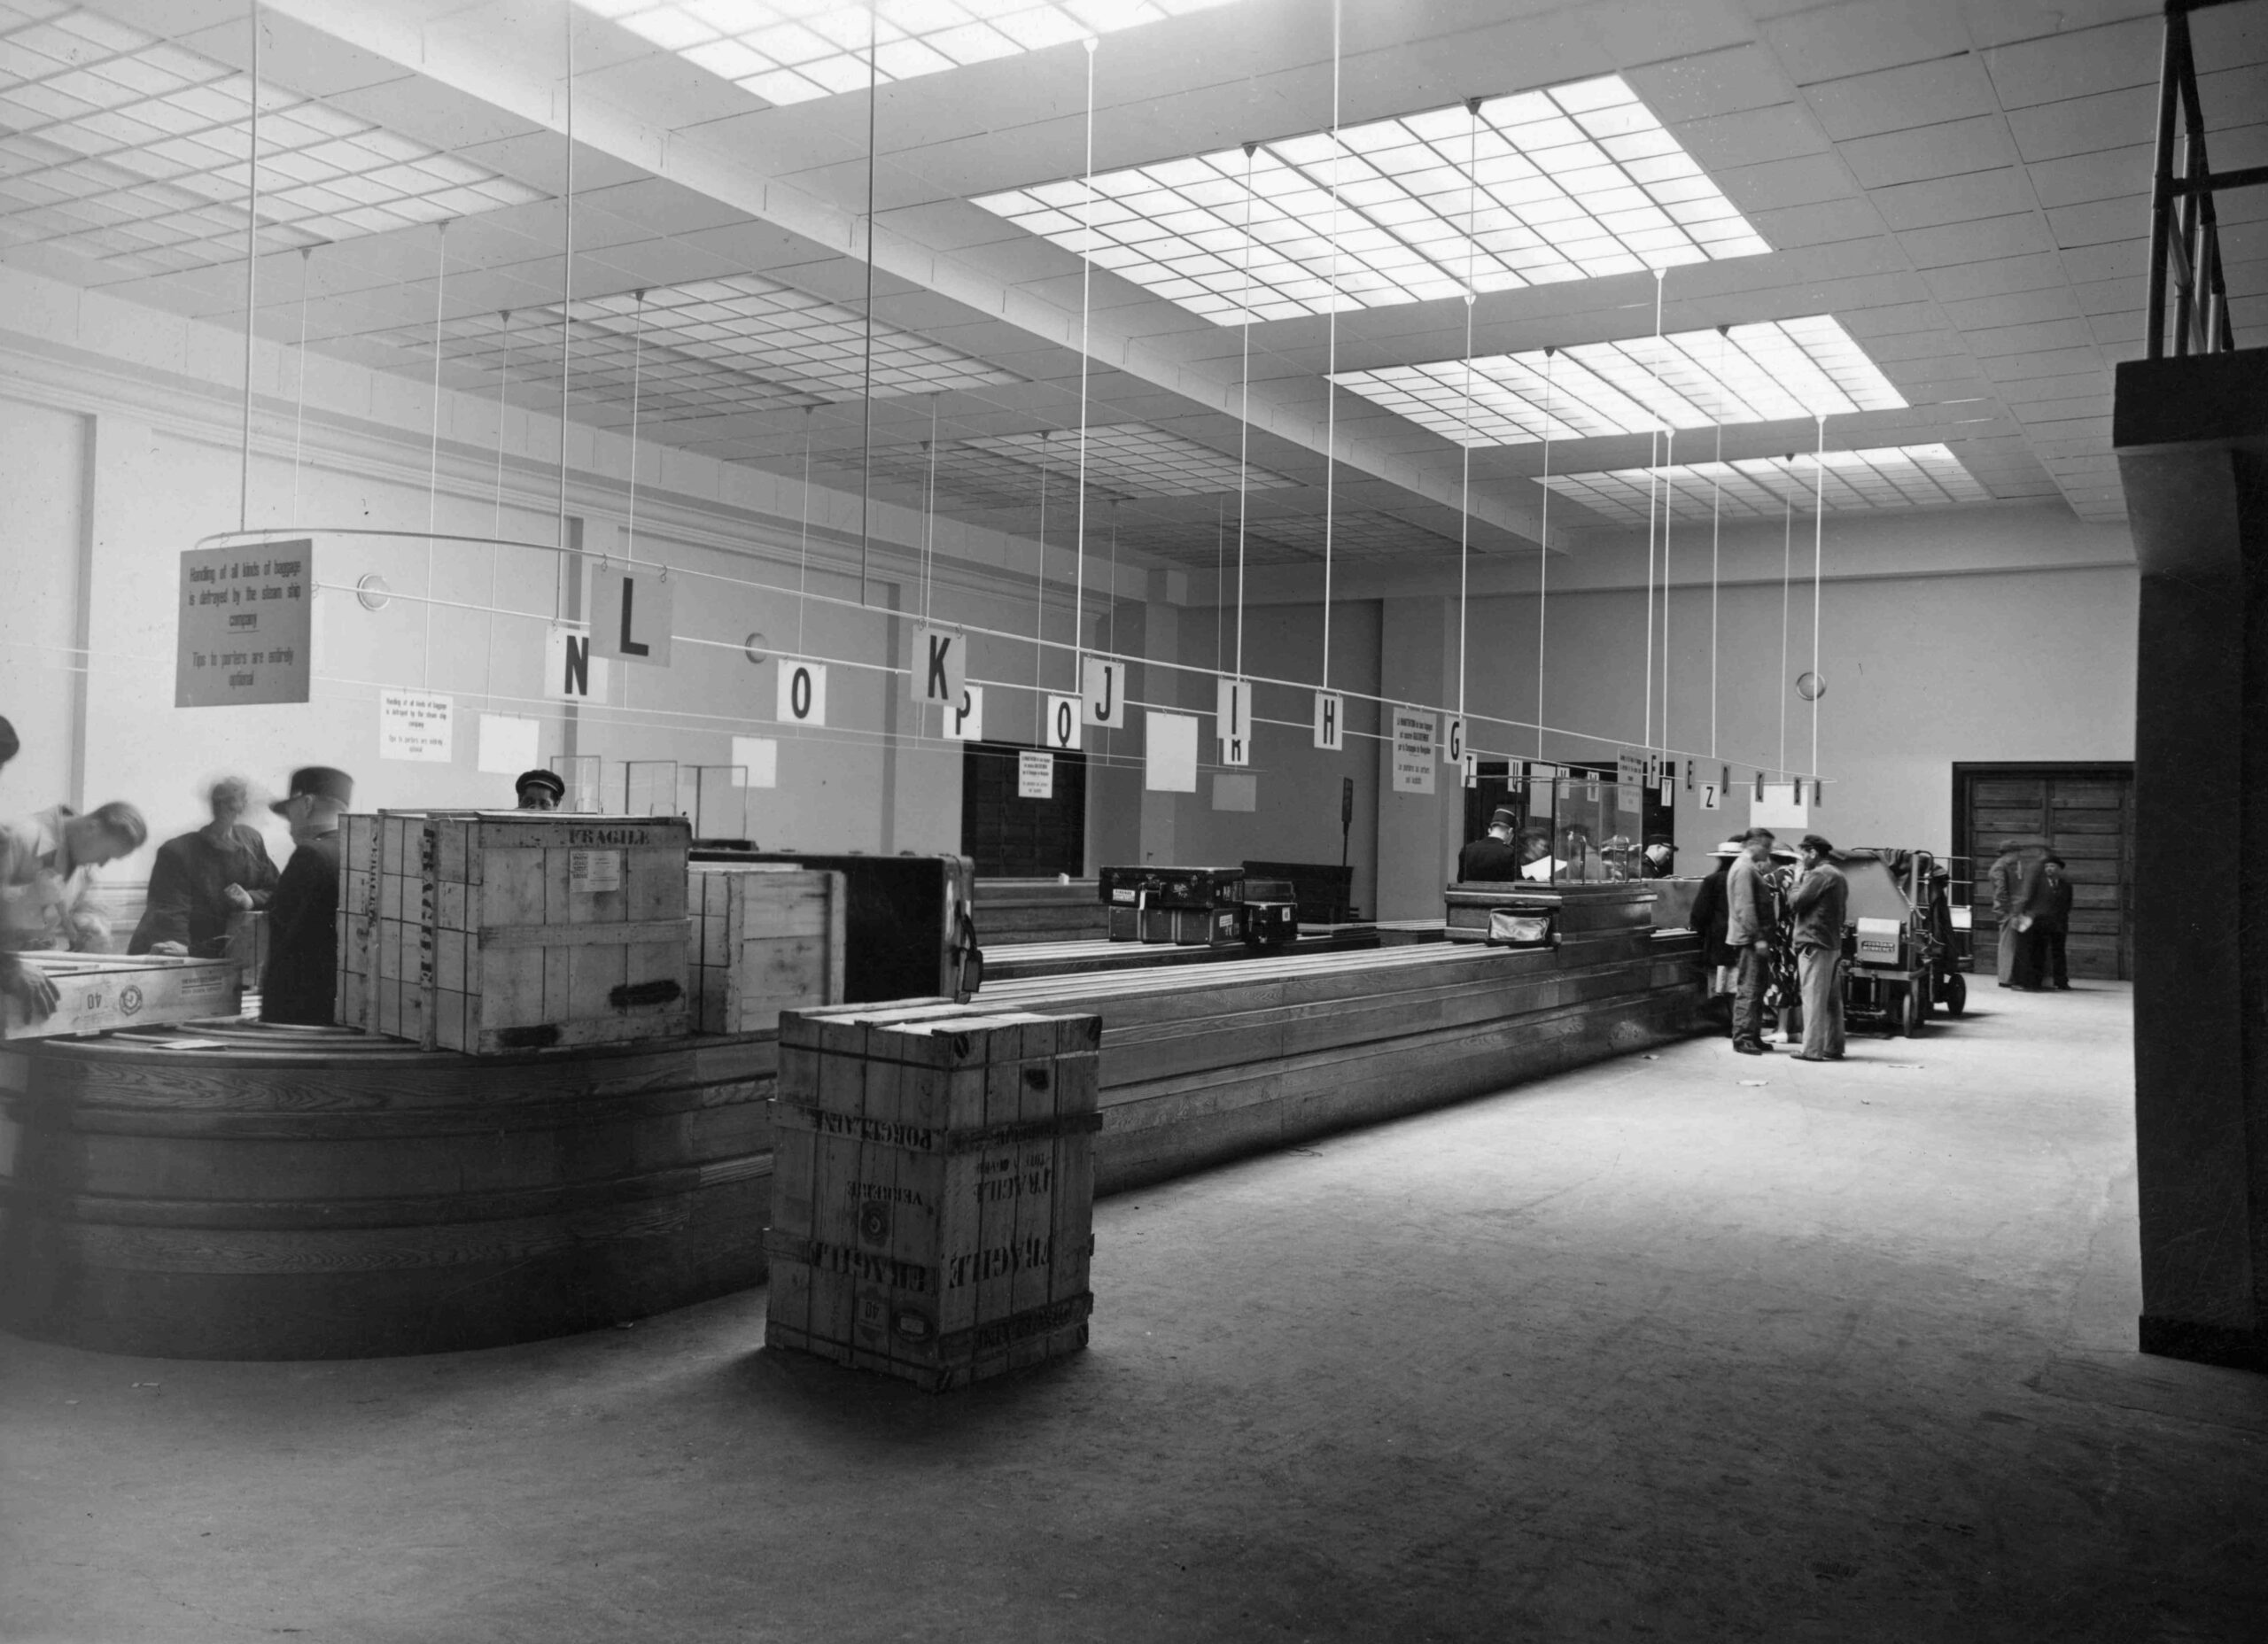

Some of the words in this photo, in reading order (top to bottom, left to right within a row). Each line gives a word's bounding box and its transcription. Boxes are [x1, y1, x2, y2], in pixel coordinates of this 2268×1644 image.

[189, 565, 215, 584] Handling
[220, 563, 227, 579] of
[242, 562, 260, 578] kinds
[264, 560, 271, 576] of
[274, 559, 302, 578] baggage
[189, 590, 195, 606] is
[199, 587, 229, 608] defrayed
[232, 586, 241, 605] by
[245, 585, 257, 601] the
[262, 585, 283, 600] steam
[287, 583, 301, 601] ship
[229, 613, 258, 629] company
[620, 578, 649, 656] L
[192, 652, 206, 670] Tips
[211, 651, 218, 666] to
[221, 650, 246, 669] porters
[252, 651, 264, 664] are
[268, 647, 294, 666] entirely
[565, 635, 589, 695] N
[928, 635, 951, 700] K
[229, 671, 255, 689] optional
[791, 666, 812, 718] O
[1095, 666, 1112, 721] J
[956, 690, 971, 735] P
[1231, 686, 1237, 734] I
[1324, 699, 1335, 745] H
[1451, 721, 1460, 761] G
[1467, 756, 1472, 785] T
[1651, 755, 1657, 786] F
[1688, 760, 1692, 789] E
[1664, 781, 1671, 804] Y
[1706, 786, 1713, 808] Z
[569, 829, 650, 845] FRAGILE
[87, 993, 102, 1010] 40
[846, 1181, 923, 1206] VERRERIE
[974, 1167, 1051, 1205] FRAGILE
[949, 1232, 1051, 1290] FRAGILE
[865, 1300, 880, 1320] 40
